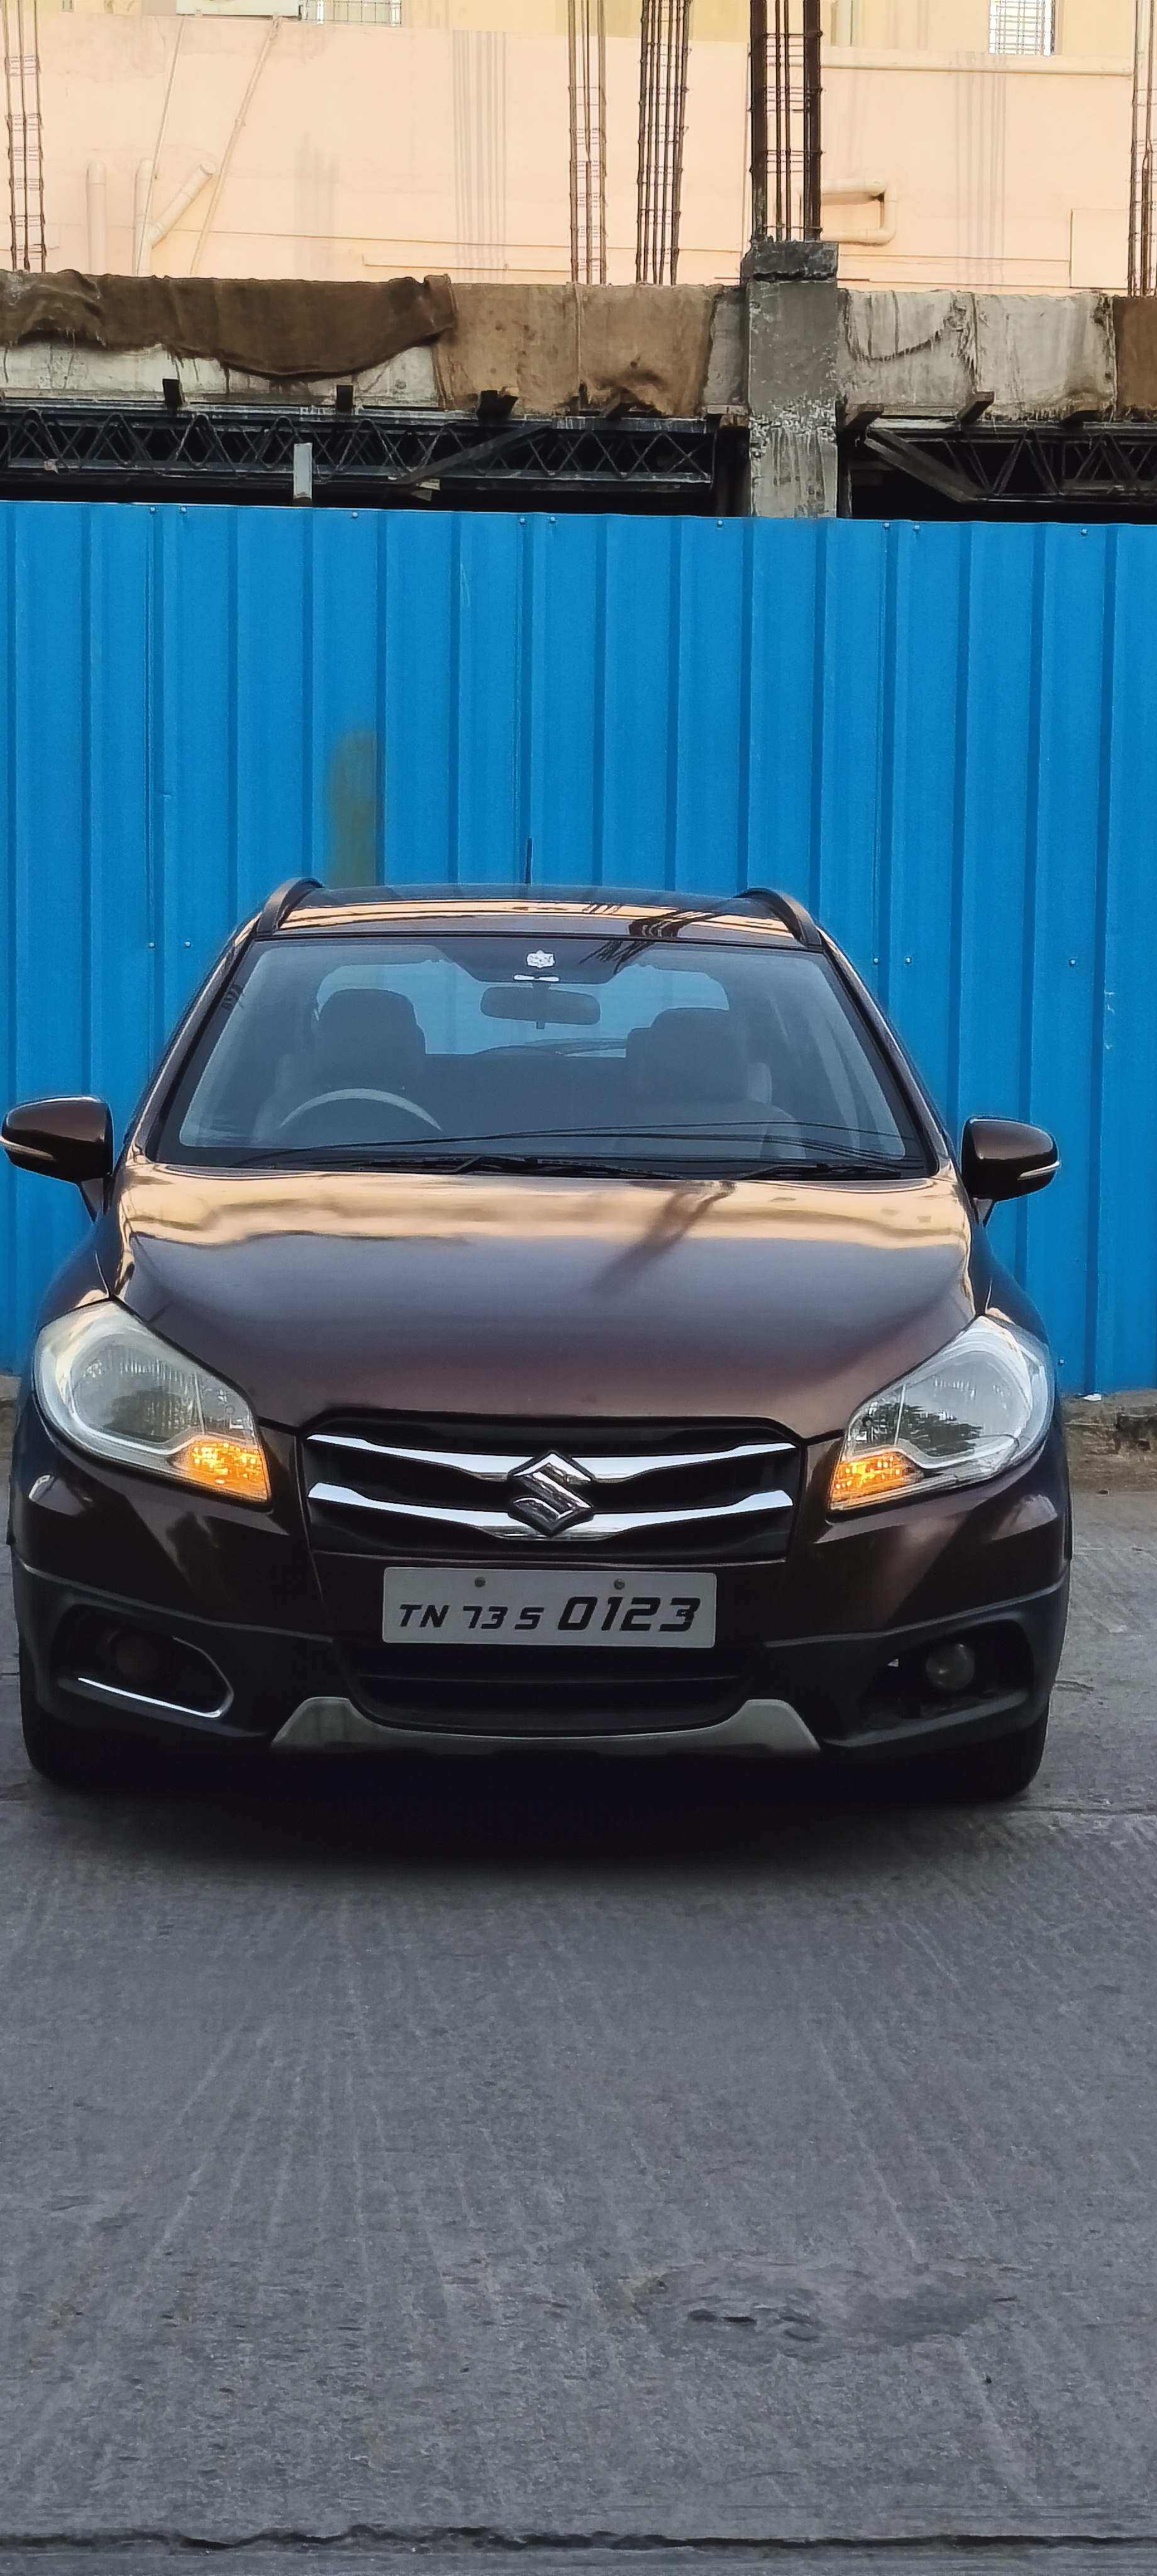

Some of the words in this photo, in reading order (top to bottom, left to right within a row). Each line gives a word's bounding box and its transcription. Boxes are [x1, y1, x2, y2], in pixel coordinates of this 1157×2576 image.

[399, 1604, 450, 1628] TN
[462, 1606, 508, 1629] 73
[514, 1607, 545, 1630] S
[557, 1596, 701, 1632] 0123
